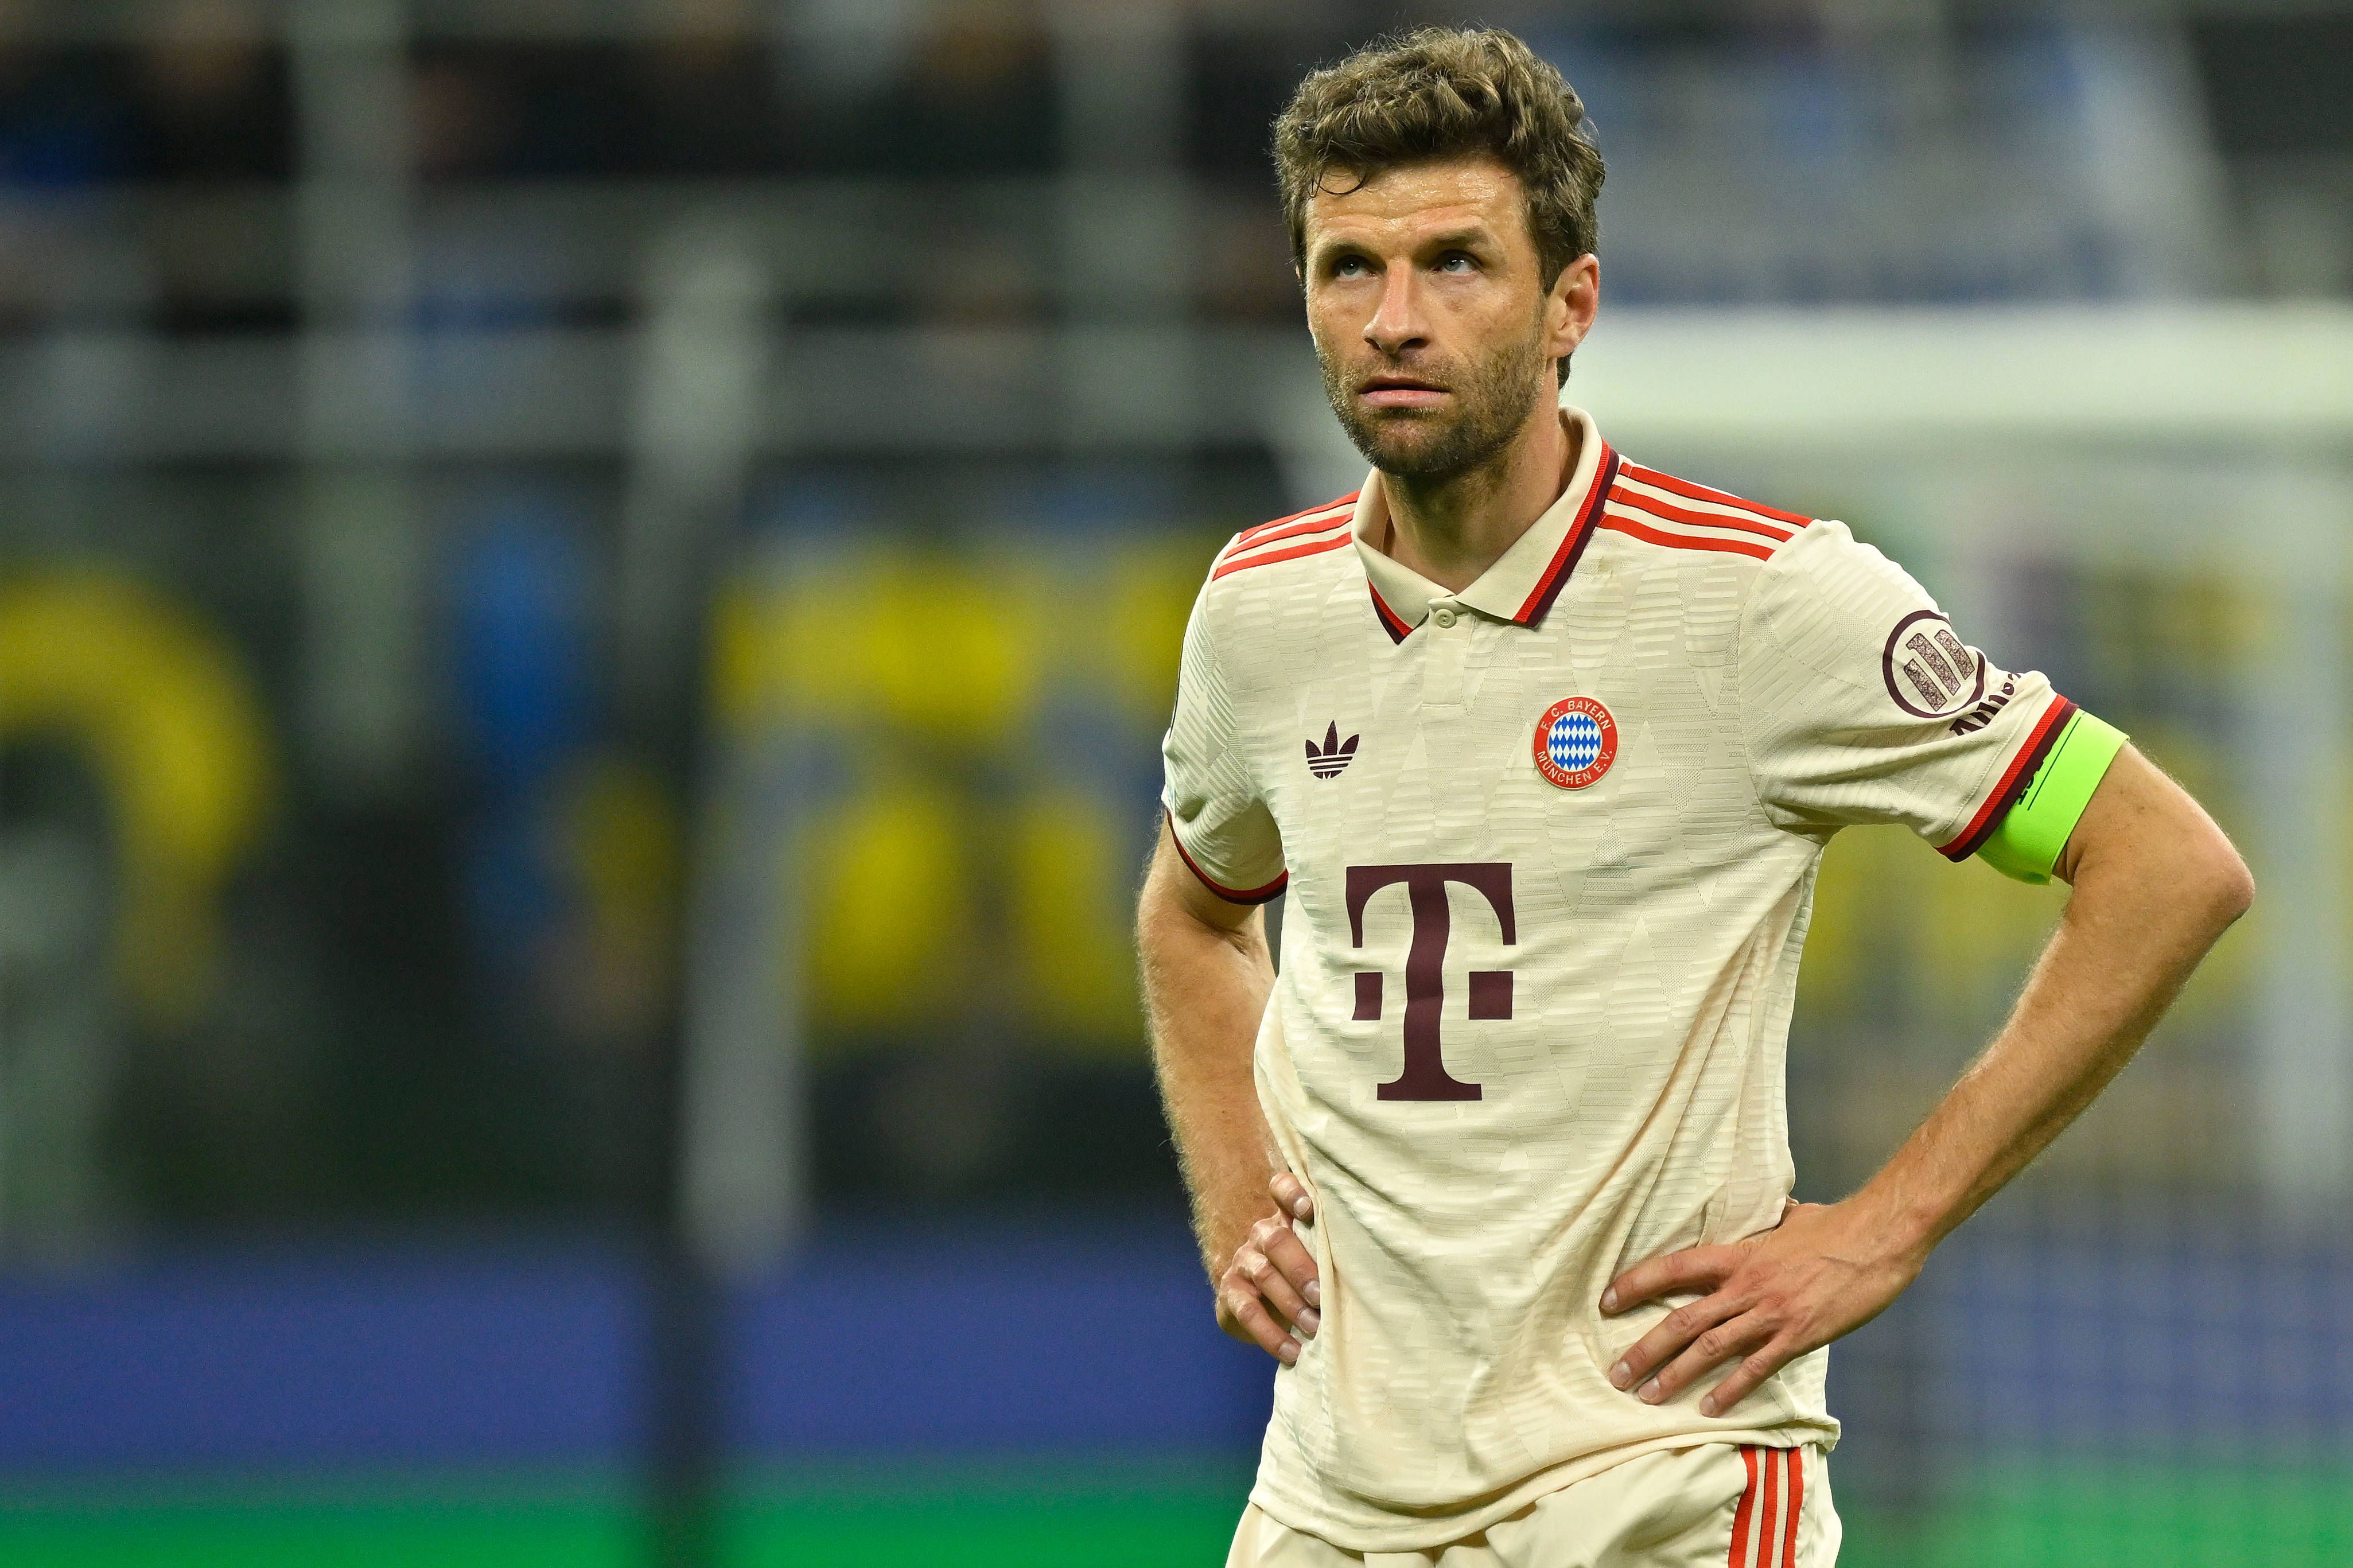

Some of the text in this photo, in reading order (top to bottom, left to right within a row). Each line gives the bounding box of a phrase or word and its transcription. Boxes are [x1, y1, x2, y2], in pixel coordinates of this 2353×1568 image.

[1568, 701, 1612, 730] BAYERN
[1537, 750, 1592, 785] MÜNCHEN
[1345, 862, 1516, 1101] T
